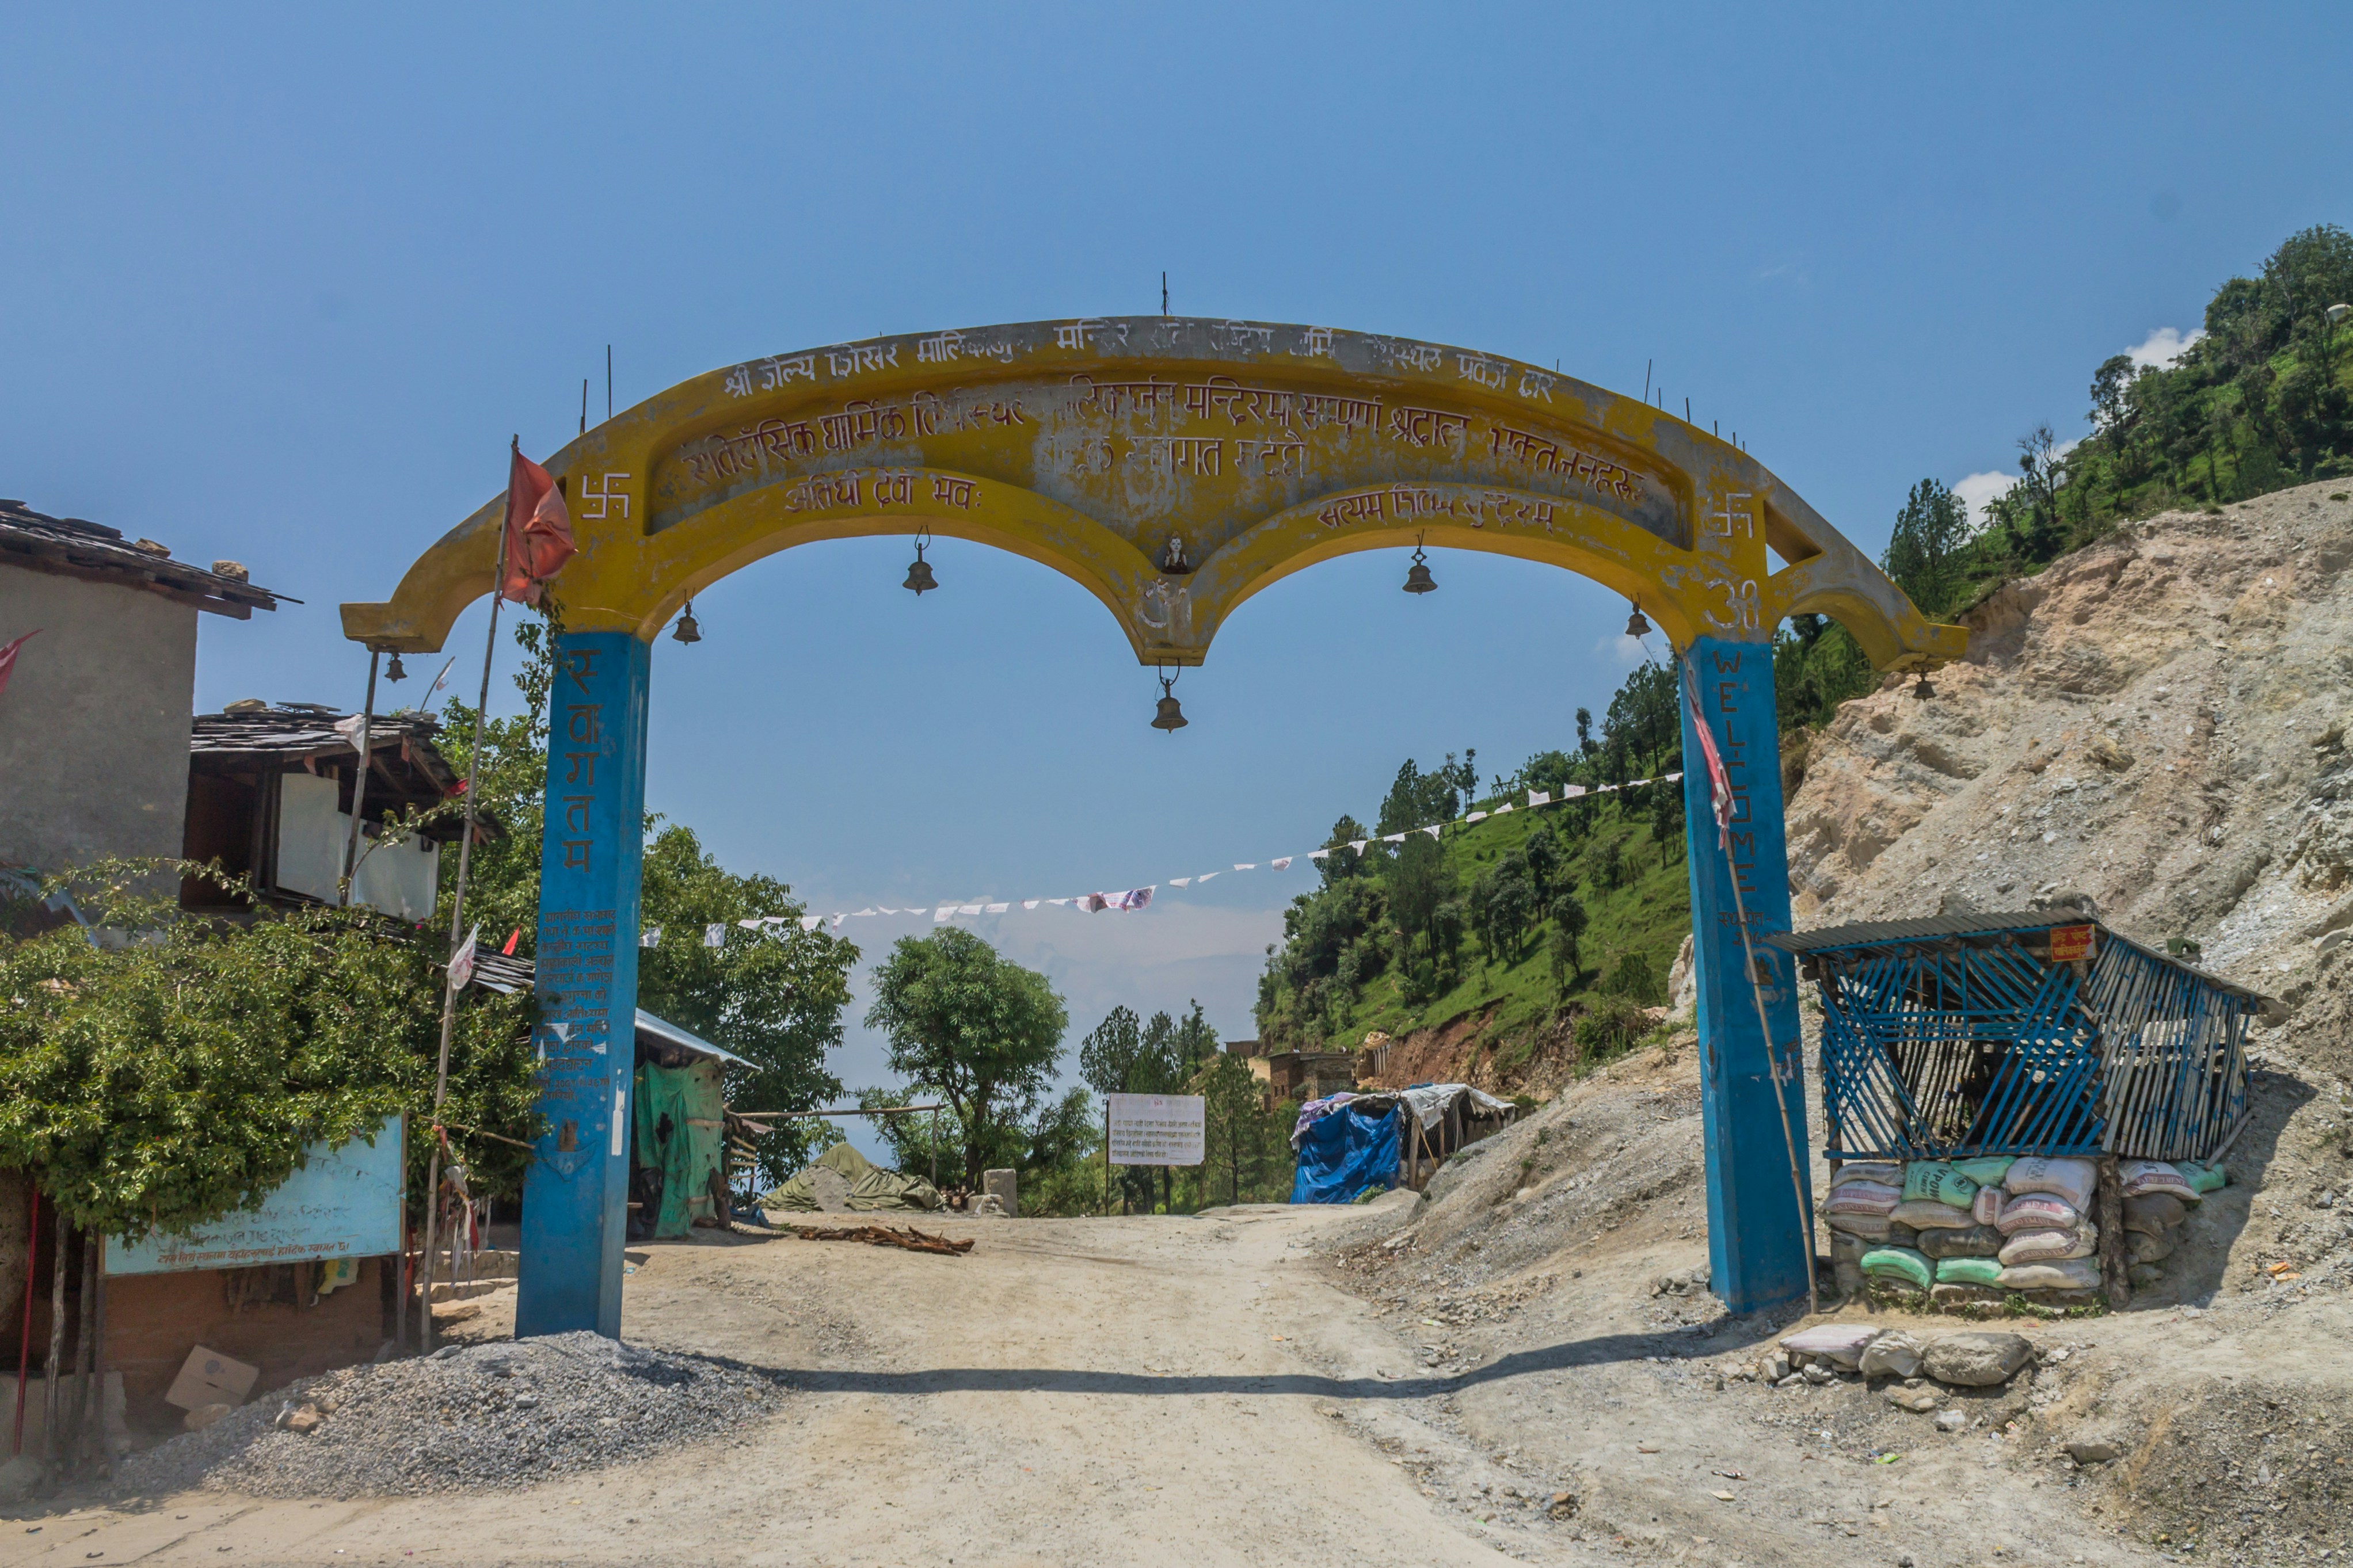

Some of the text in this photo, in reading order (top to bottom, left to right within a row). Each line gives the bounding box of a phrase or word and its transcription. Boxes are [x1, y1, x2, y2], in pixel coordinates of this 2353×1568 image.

[724, 364, 752, 399] श्री
[824, 344, 899, 377] शिखर
[1456, 351, 1511, 391] प्रवेश
[1317, 490, 1388, 530] सत्यम
